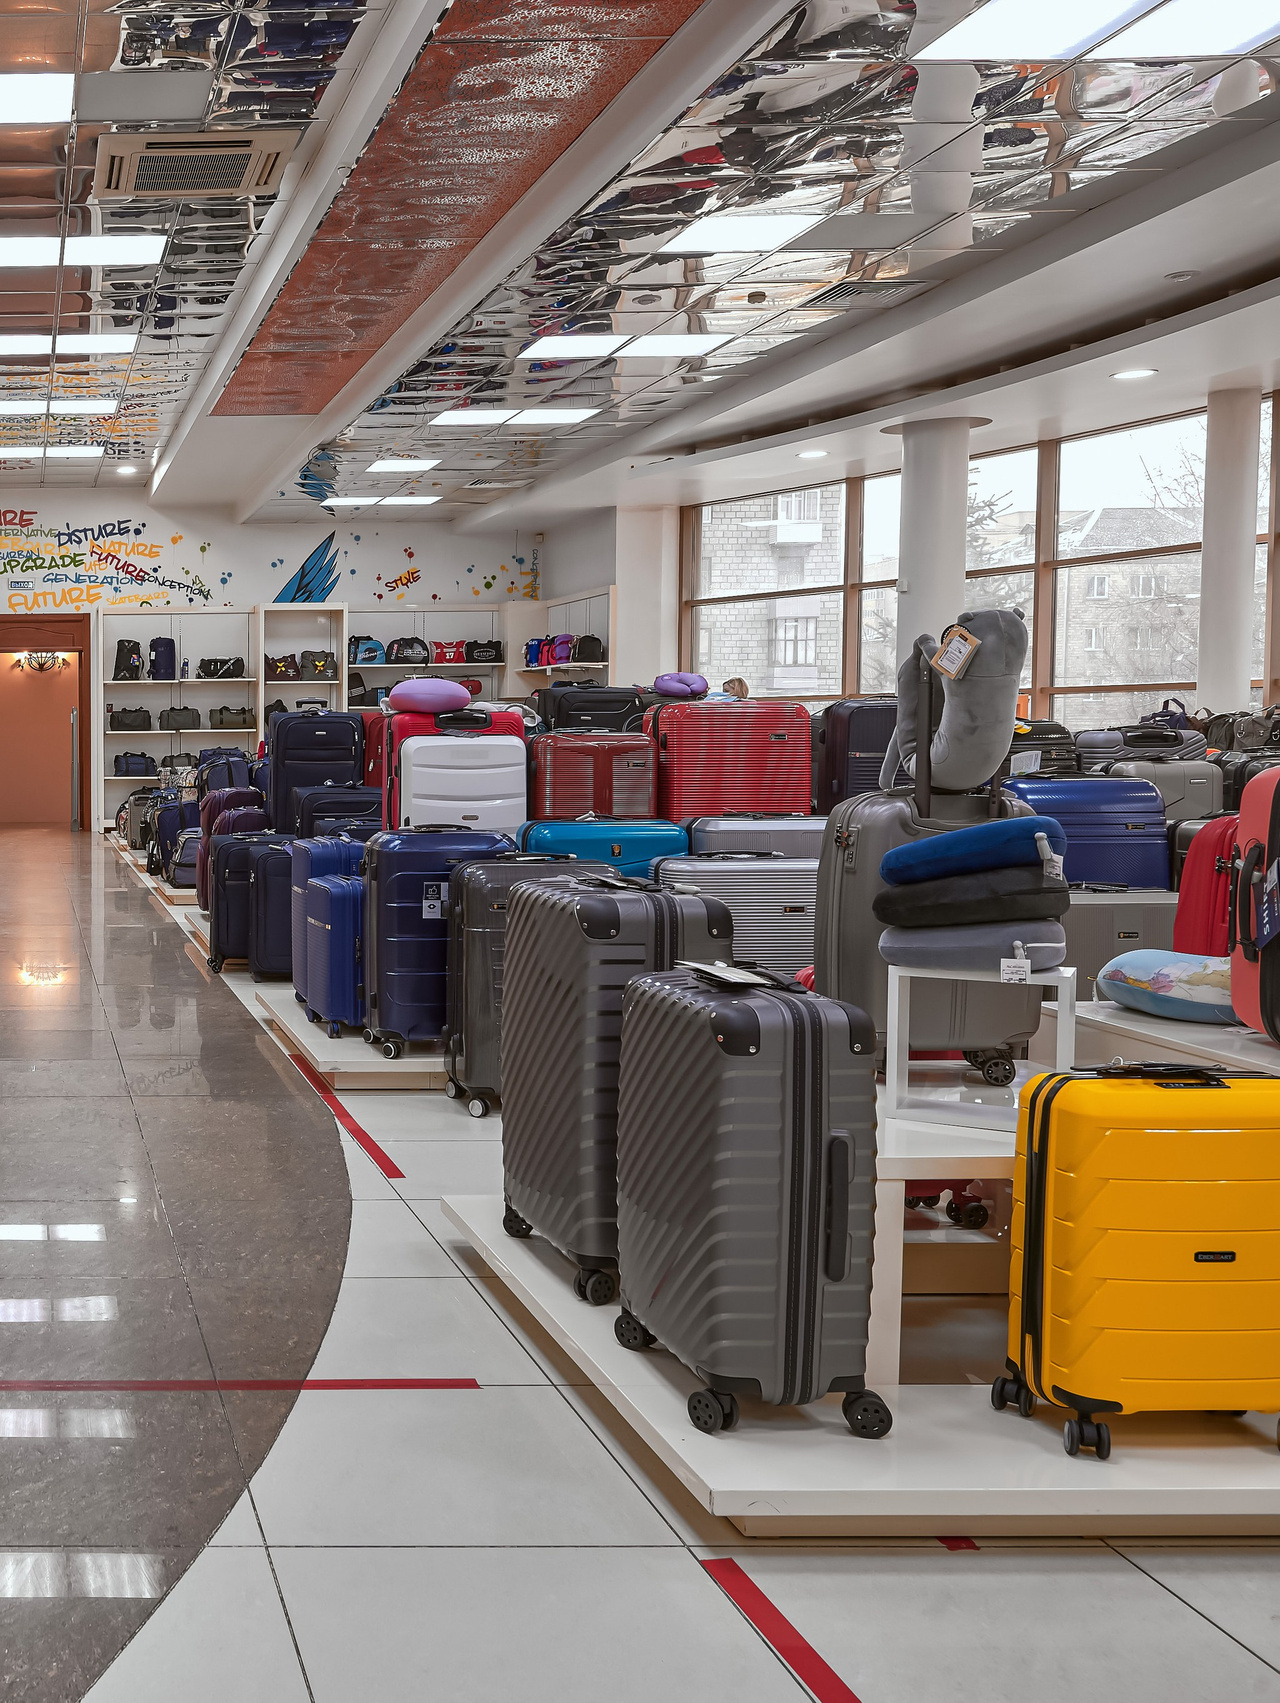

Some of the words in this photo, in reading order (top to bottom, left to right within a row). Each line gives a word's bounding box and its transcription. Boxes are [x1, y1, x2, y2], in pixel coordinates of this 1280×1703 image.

[89, 538, 164, 559] NATURE
[89, 544, 150, 582] FUTURE
[42, 571, 144, 586] GENERATION
[385, 570, 421, 592] STYLE
[8, 585, 104, 613] FUTURE
[106, 591, 169, 605] SKATEBOARD
